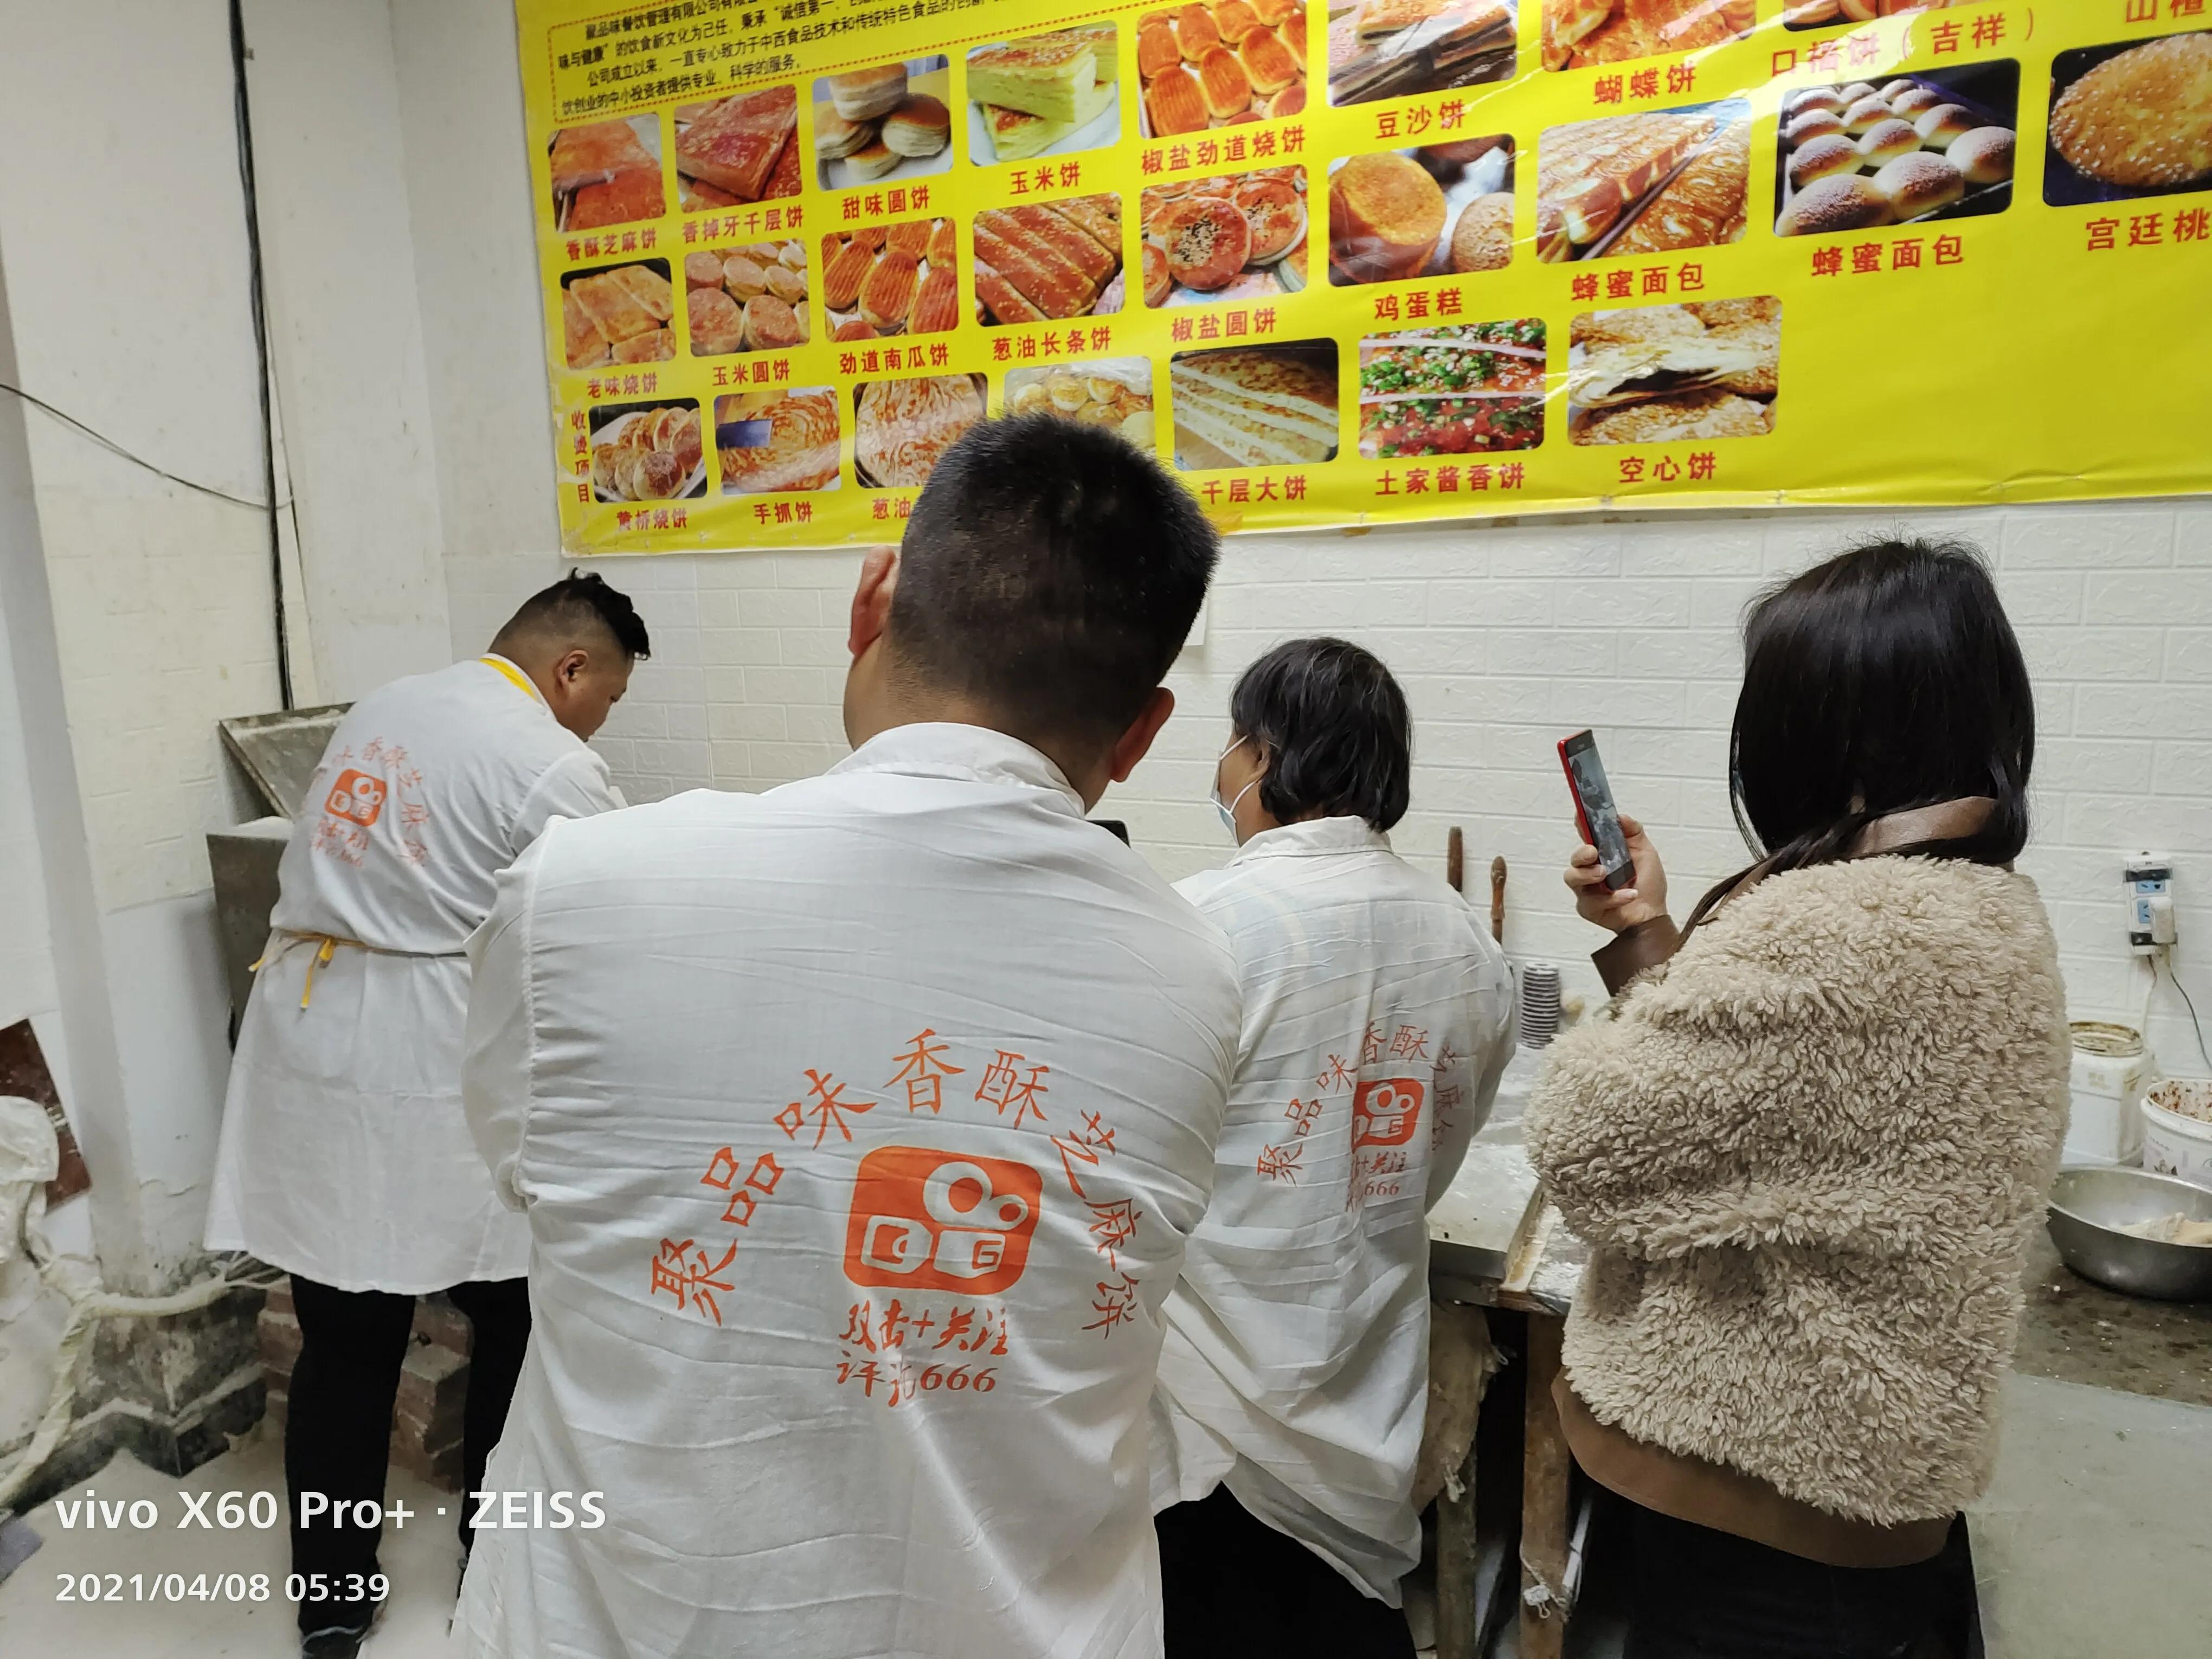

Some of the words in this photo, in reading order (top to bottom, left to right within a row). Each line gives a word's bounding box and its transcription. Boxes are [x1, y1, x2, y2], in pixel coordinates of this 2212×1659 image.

[1594, 60, 1696, 105] 蝴蝶饼
[1376, 100, 1465, 139] 豆沙饼
[1141, 124, 1306, 176] 椒盐劲道烧饼
[1011, 162, 1081, 195] 玉米饼
[842, 184, 930, 219] 甜味圆饼
[566, 228, 658, 261] 香酥芝麻饼
[2085, 208, 2211, 251] 宫廷桃
[1811, 234, 1964, 277] 蜂蜜面包
[1571, 262, 1705, 301] 蜂蜜面包
[1374, 287, 1463, 321] 鸡蛋糕
[1171, 308, 1276, 342] 椒盐圆饼
[839, 343, 949, 375] 劲道南瓜饼
[993, 326, 1111, 362] 葱油长条饼
[712, 358, 790, 387] 玉米圆饼
[1375, 461, 1525, 496] 土家酱香饼
[1619, 451, 1717, 484] 空心饼
[1201, 475, 1308, 504] 千层大饼
[616, 507, 687, 531] 黄桥烧饼
[754, 501, 813, 525] 手抓饼
[651, 1028, 1143, 1339] 聚品味香酥芝麻饼
